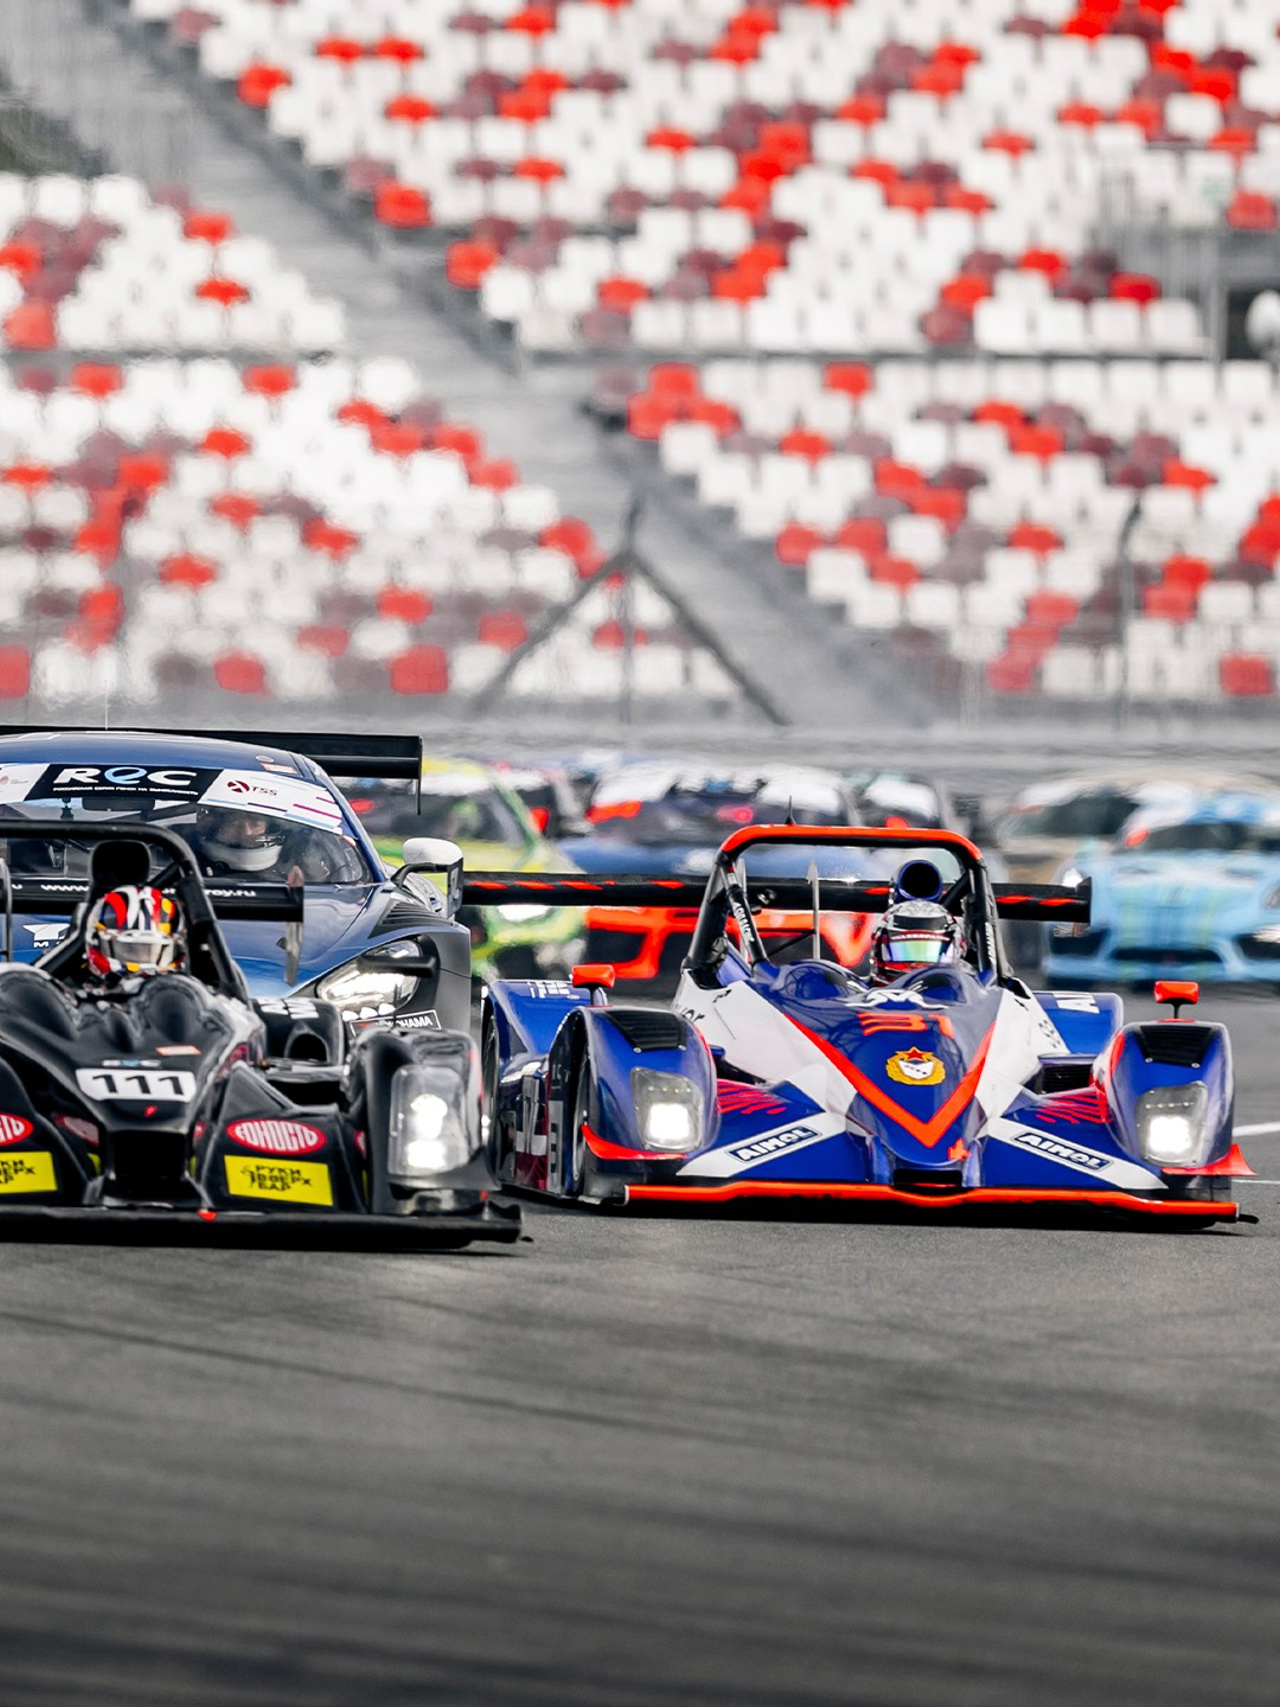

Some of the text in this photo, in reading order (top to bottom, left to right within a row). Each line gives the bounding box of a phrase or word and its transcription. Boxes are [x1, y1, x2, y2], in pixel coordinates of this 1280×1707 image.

[251, 786, 277, 797] TSS
[92, 1074, 184, 1095] 111
[735, 1127, 813, 1161] AIMOL
[1018, 1134, 1102, 1169] AIMOL
